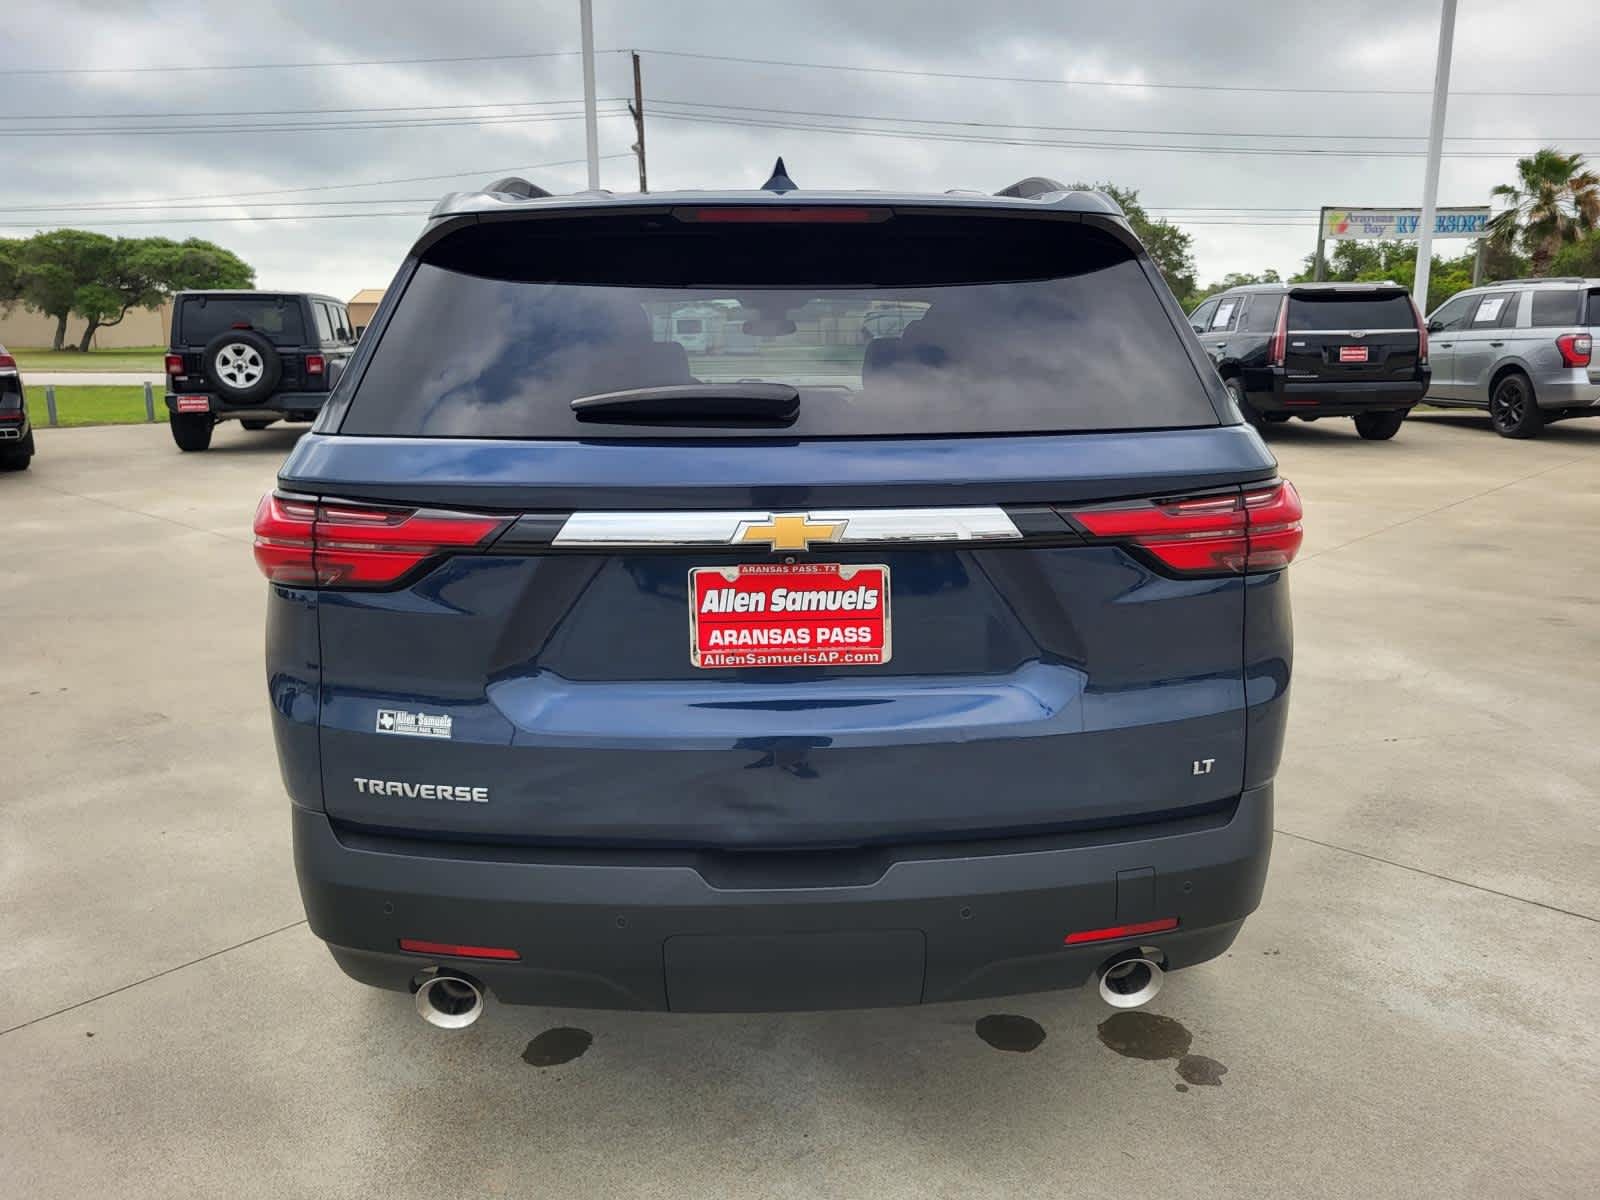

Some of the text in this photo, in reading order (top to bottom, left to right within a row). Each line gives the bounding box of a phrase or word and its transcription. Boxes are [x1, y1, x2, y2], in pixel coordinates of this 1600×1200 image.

[1364, 224, 1386, 237] Bay
[701, 586, 879, 614] Allen Samuels
[709, 626, 872, 646] ARANSAS PASS
[703, 652, 879, 666] AllenSamuelsAP.com
[1193, 758, 1215, 775] LT
[353, 777, 489, 803] TRAVERSE
